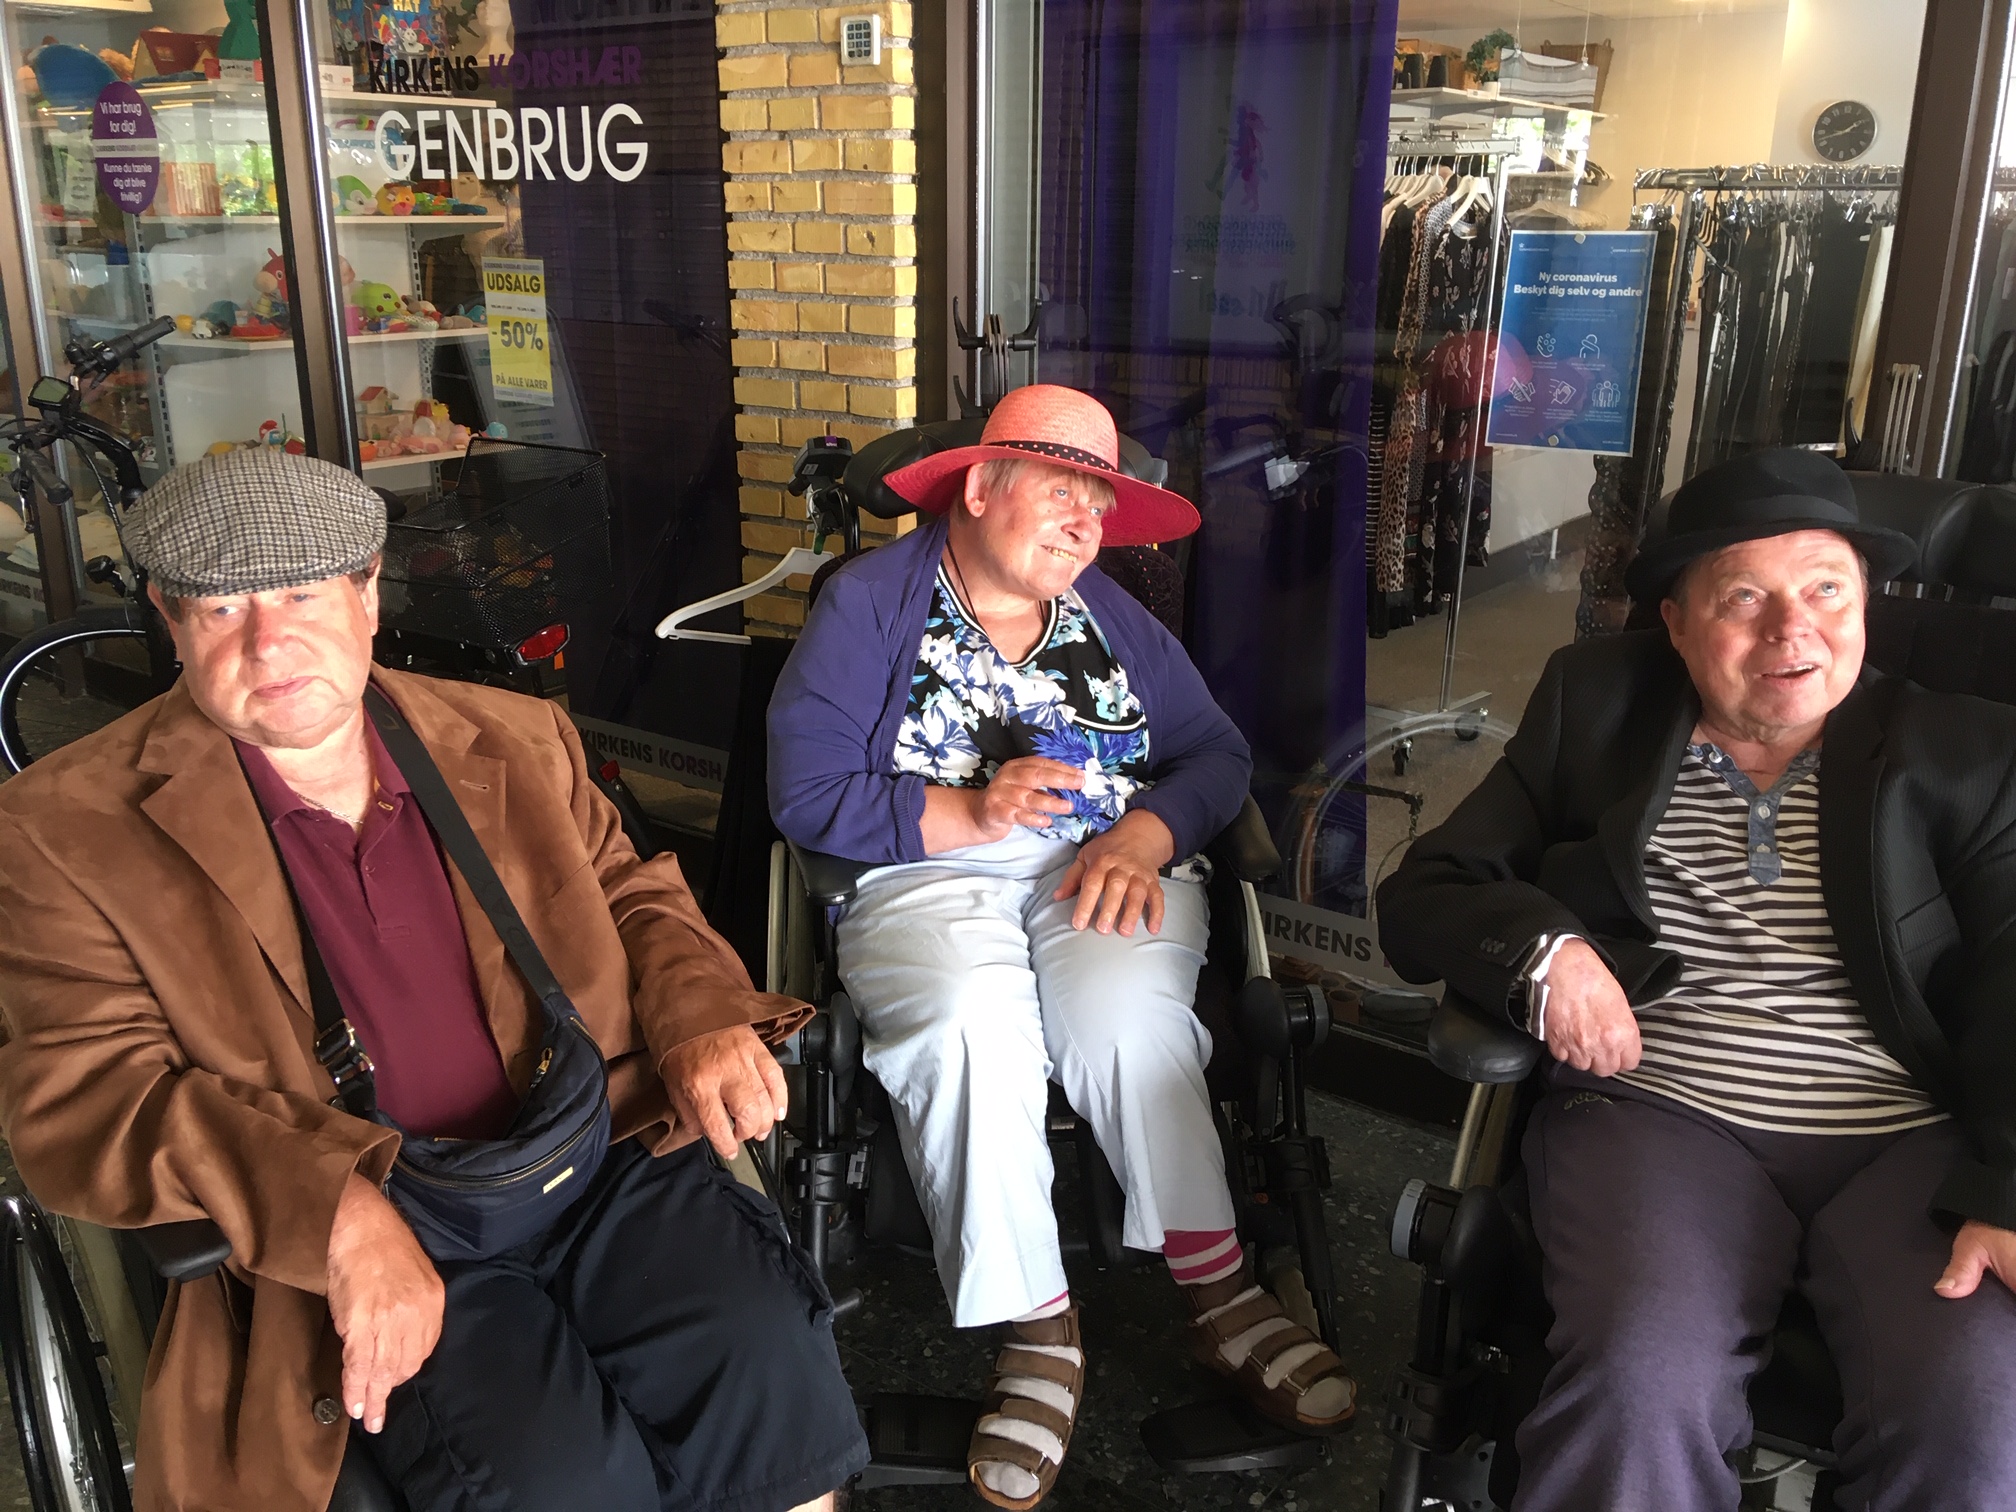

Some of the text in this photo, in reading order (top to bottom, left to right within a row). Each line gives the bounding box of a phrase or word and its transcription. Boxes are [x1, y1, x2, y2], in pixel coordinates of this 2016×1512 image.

[369, 46, 642, 93] KIRKENS KORSHÆR
[100, 101, 142, 116] Vi har brug
[110, 120, 136, 135] for dig!
[374, 103, 648, 183] GENBRUG
[104, 163, 122, 173] Kunne
[123, 163, 132, 173] du
[113, 178, 123, 190] dig
[131, 178, 146, 188] blive
[486, 272, 541, 293] UDSALG
[1539, 271, 1617, 284] Ny coronavirus
[1513, 284, 1642, 298] Beskyt dig selv og andre
[496, 372, 548, 390] PÅ ALLE VARER
[1260, 909, 1371, 962] IRKENS
